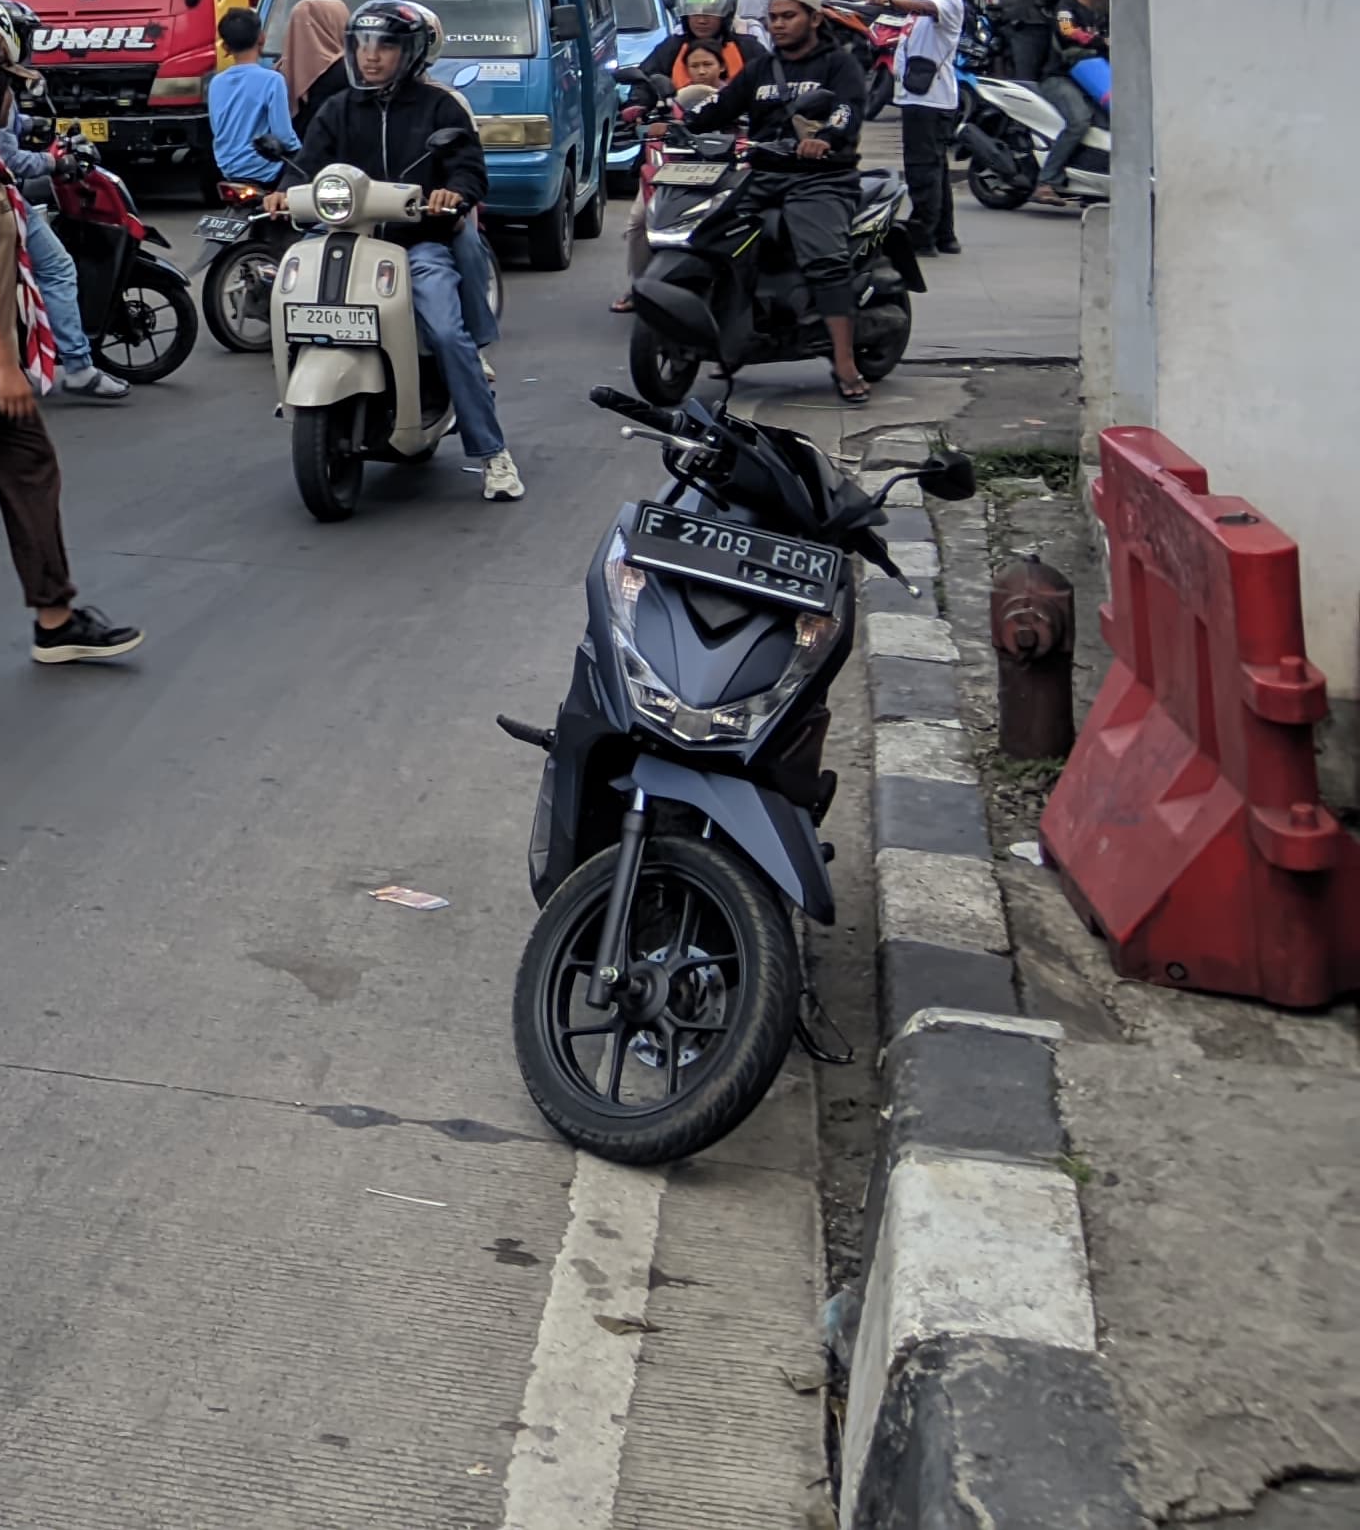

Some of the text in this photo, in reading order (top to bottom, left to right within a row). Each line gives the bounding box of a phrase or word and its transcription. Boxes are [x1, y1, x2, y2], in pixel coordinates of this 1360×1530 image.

[445, 33, 518, 43] CICURUG
[290, 308, 299, 323] F
[348, 311, 374, 325] UCY
[645, 513, 665, 534] F
[678, 522, 751, 557] 2709
